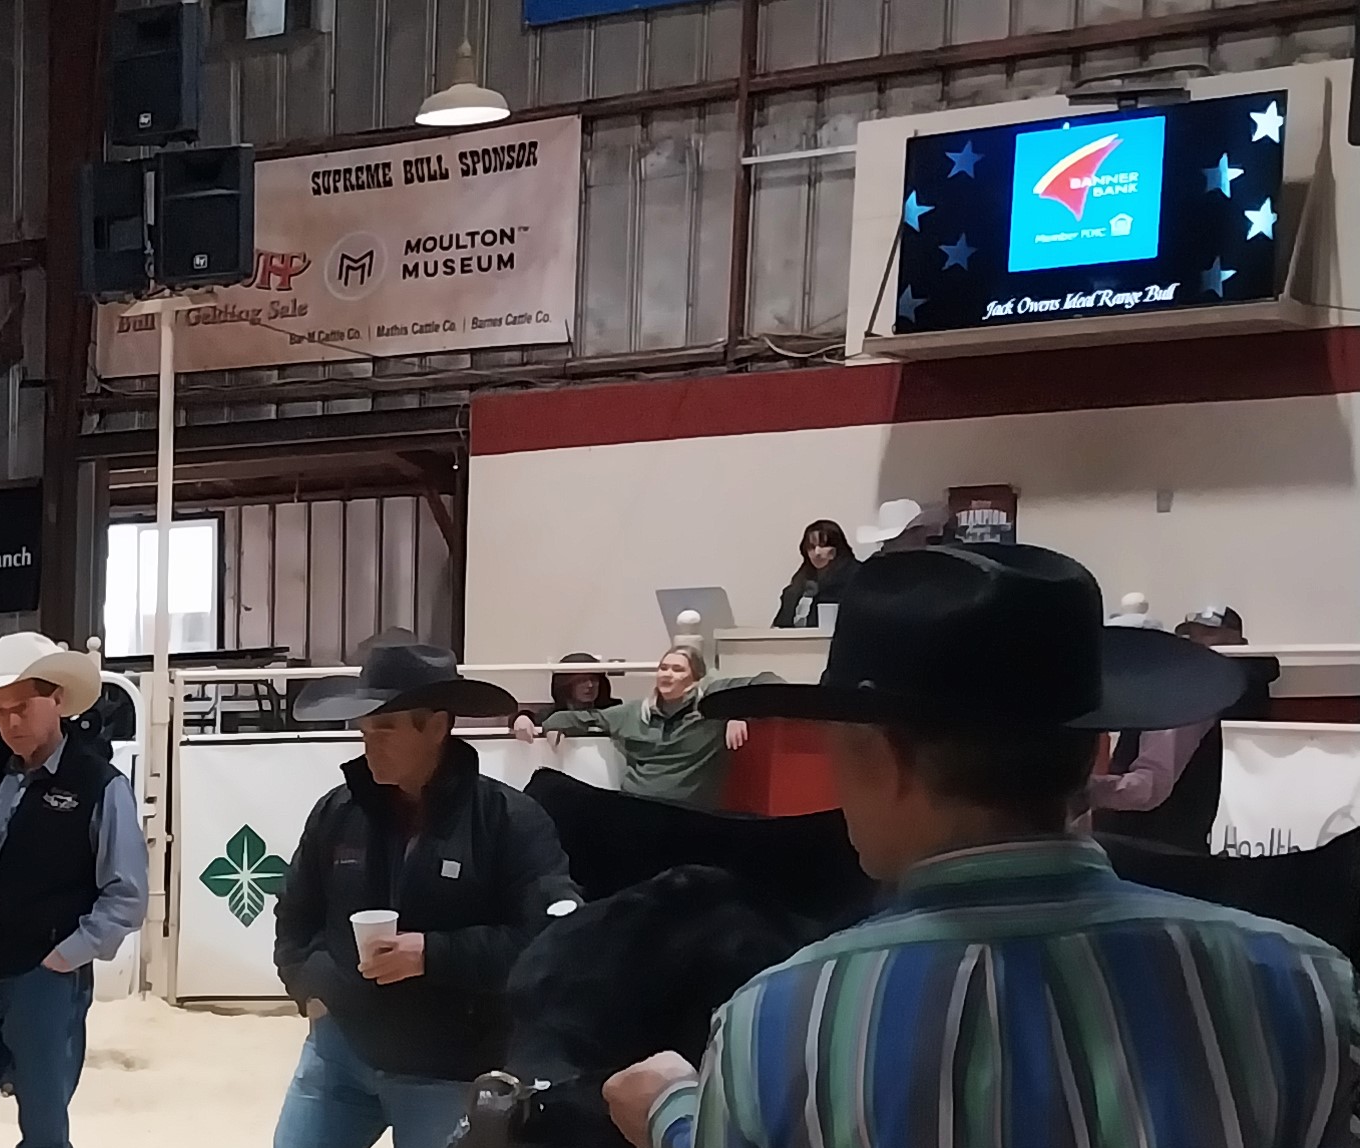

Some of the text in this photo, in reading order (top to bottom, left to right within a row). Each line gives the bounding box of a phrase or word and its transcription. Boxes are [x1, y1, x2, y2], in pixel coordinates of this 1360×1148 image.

[311, 140, 539, 196] SUPREME BULL SPONSOR
[1069, 172, 1139, 189] BANNER
[1092, 183, 1138, 198] BANK
[402, 252, 516, 280] MUSEUM
[266, 298, 308, 321] Sale
[1016, 296, 1060, 315] Owens
[1143, 283, 1180, 304] Bull
